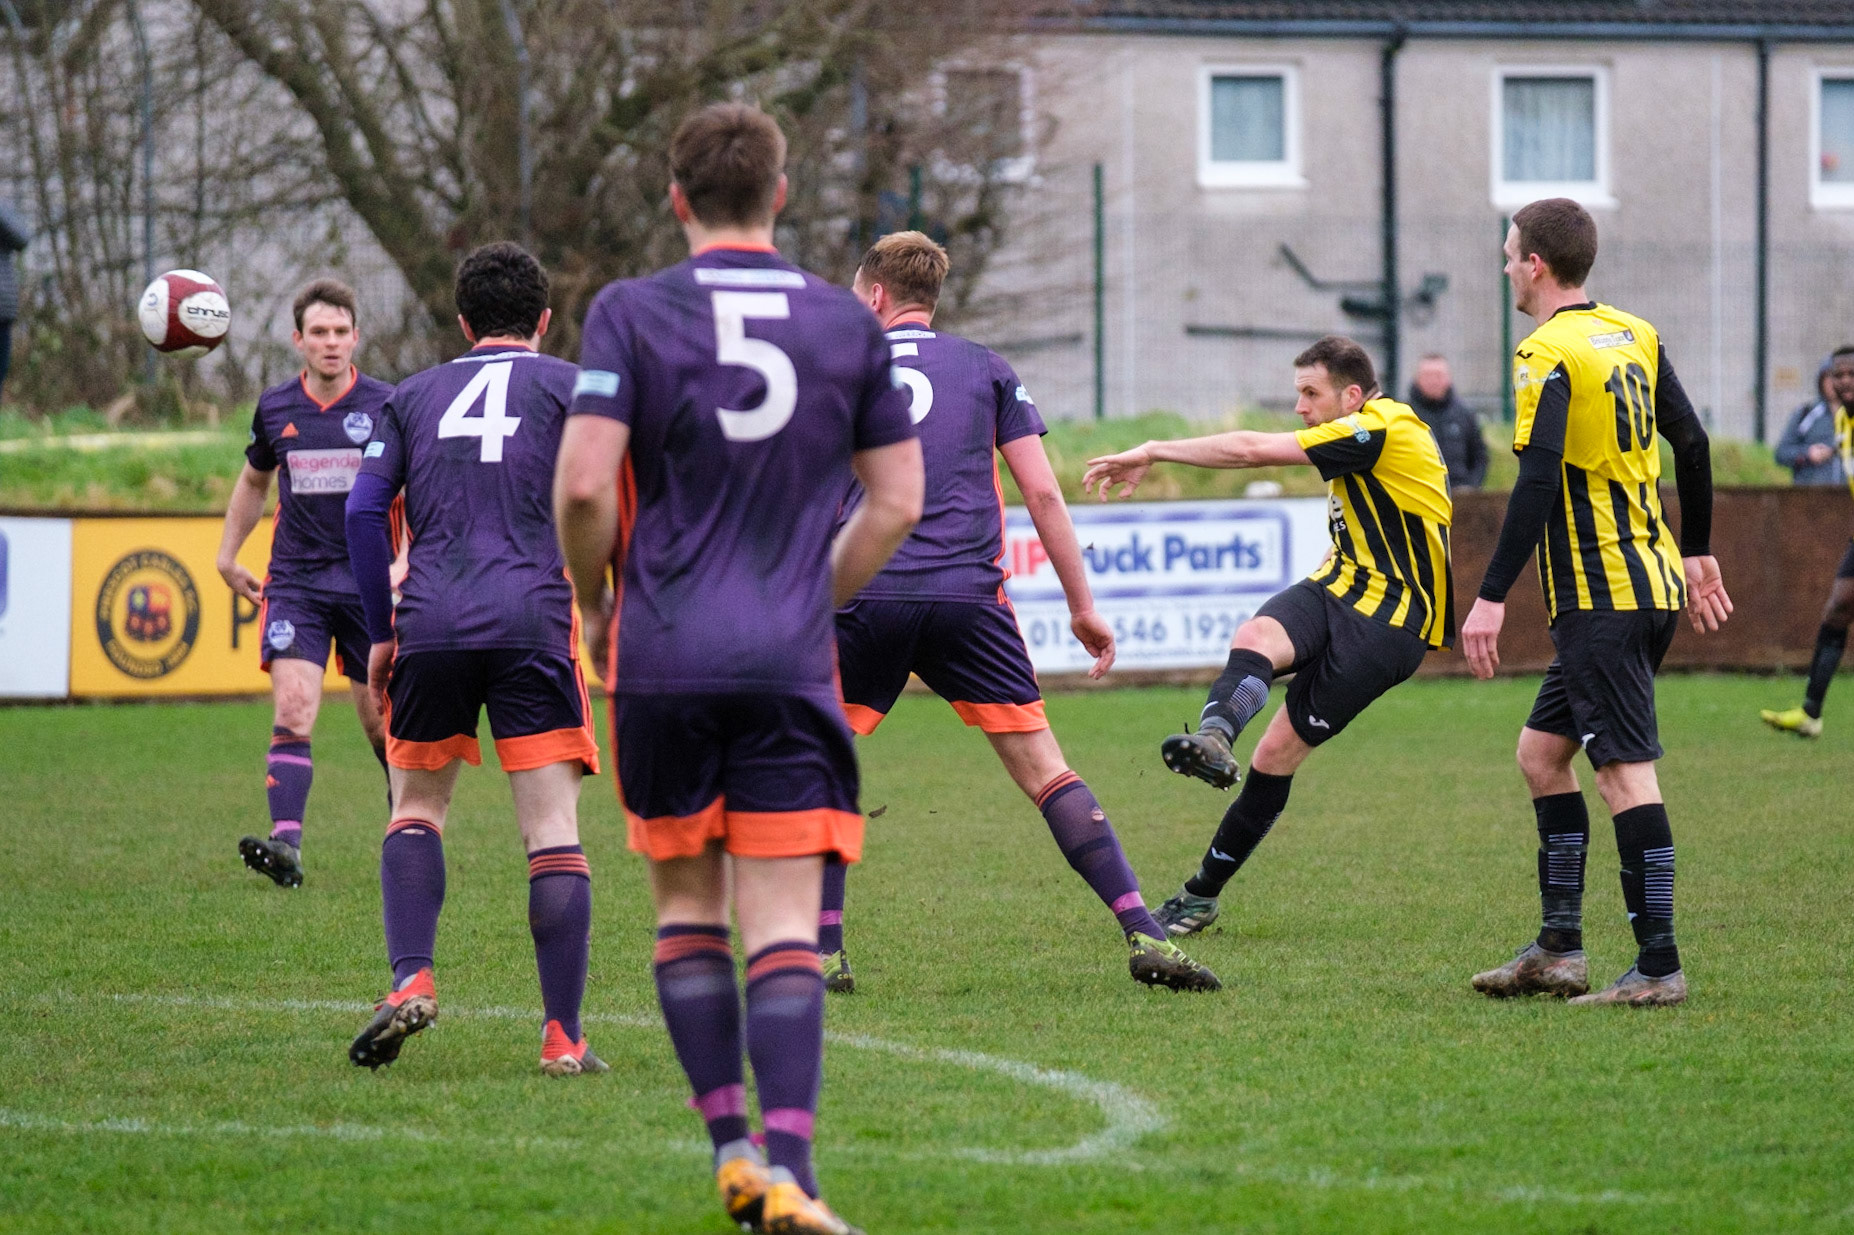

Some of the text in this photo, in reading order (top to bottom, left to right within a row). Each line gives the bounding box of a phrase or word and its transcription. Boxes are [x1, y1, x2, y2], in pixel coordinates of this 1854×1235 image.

[711, 290, 798, 442] 5
[1604, 362, 1654, 453] 10
[437, 361, 522, 463] 4
[289, 453, 360, 473] Regenda
[1163, 534, 1262, 571] Parts
